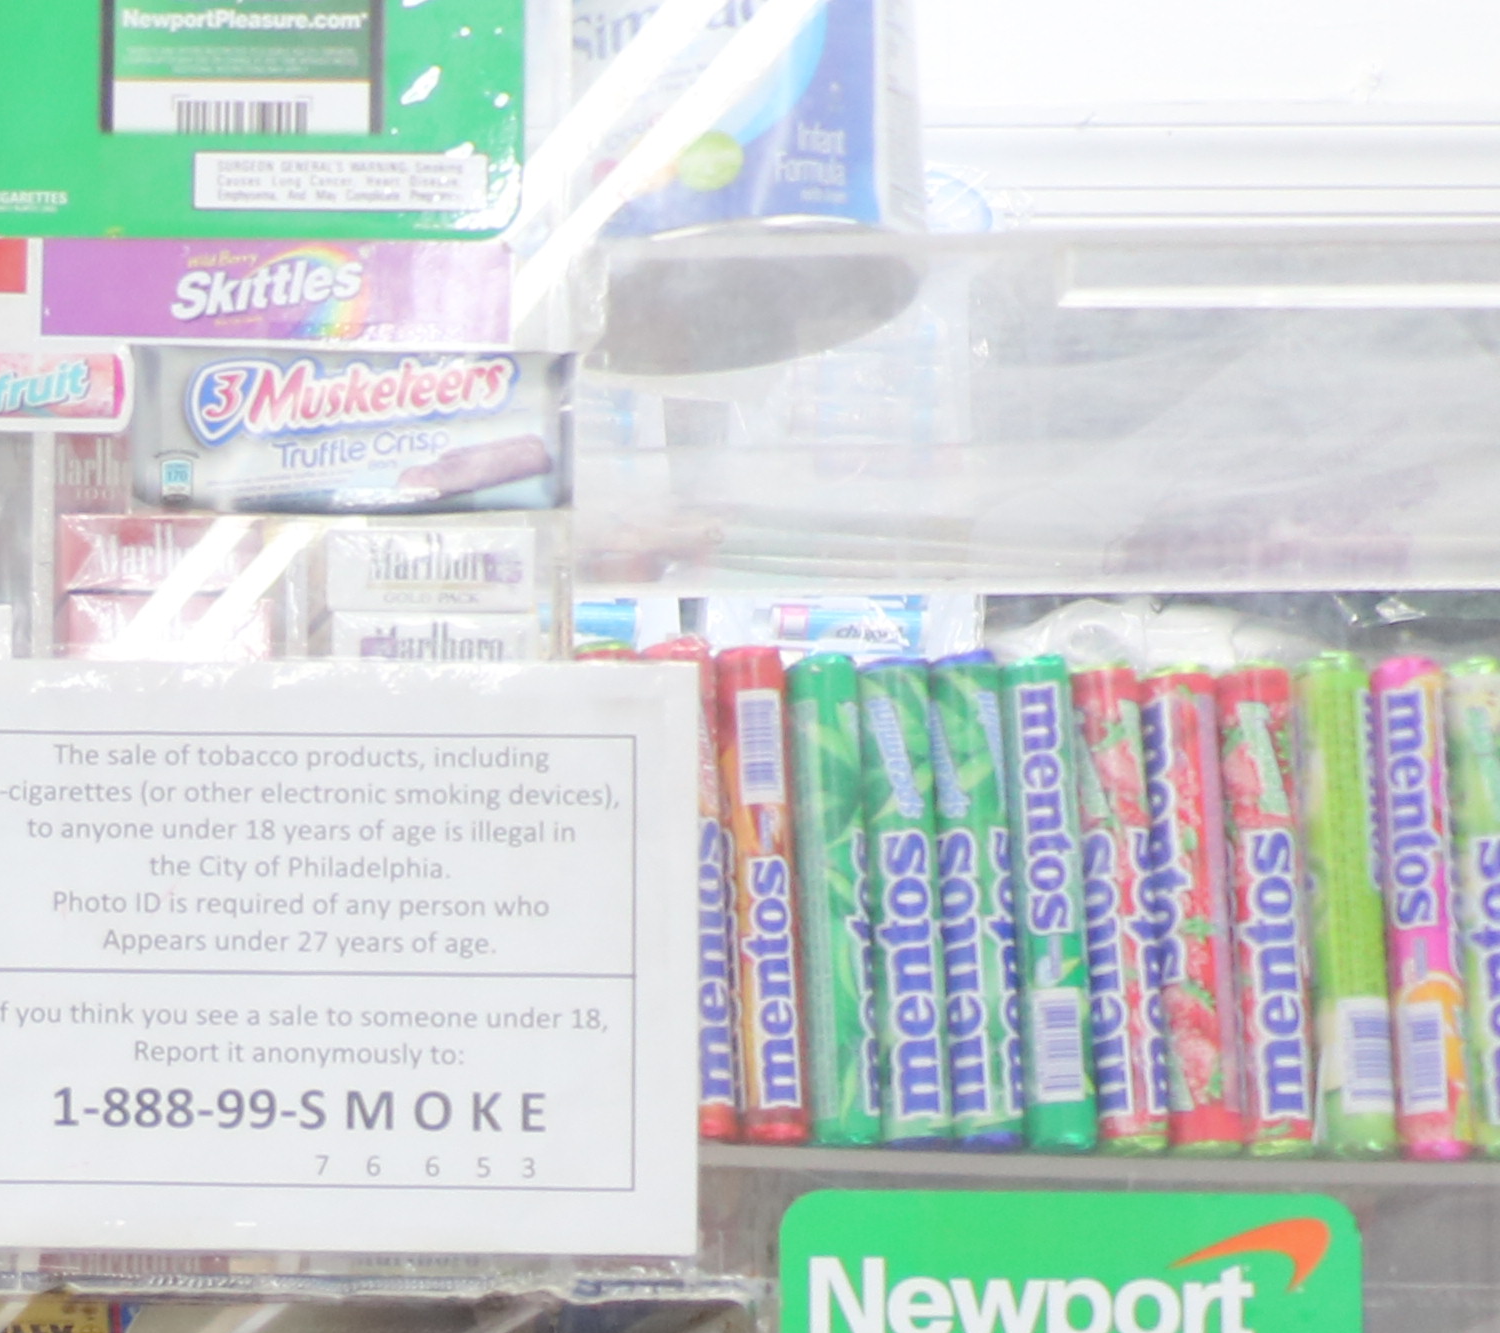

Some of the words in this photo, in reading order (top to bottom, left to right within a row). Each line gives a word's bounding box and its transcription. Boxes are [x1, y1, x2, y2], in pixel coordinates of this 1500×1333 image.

[171, 249, 363, 321] Skittles
[250, 358, 516, 425] Musketeers
[273, 435, 368, 470] Truffle
[375, 427, 450, 466] Crisp
[53, 744, 100, 767] The
[106, 746, 157, 768] sale
[165, 744, 190, 768] of
[198, 744, 298, 769] tobacco
[307, 747, 427, 774] products,
[433, 747, 549, 775] including
[1382, 689, 1437, 929] mentos
[1241, 830, 1305, 1119] mentos
